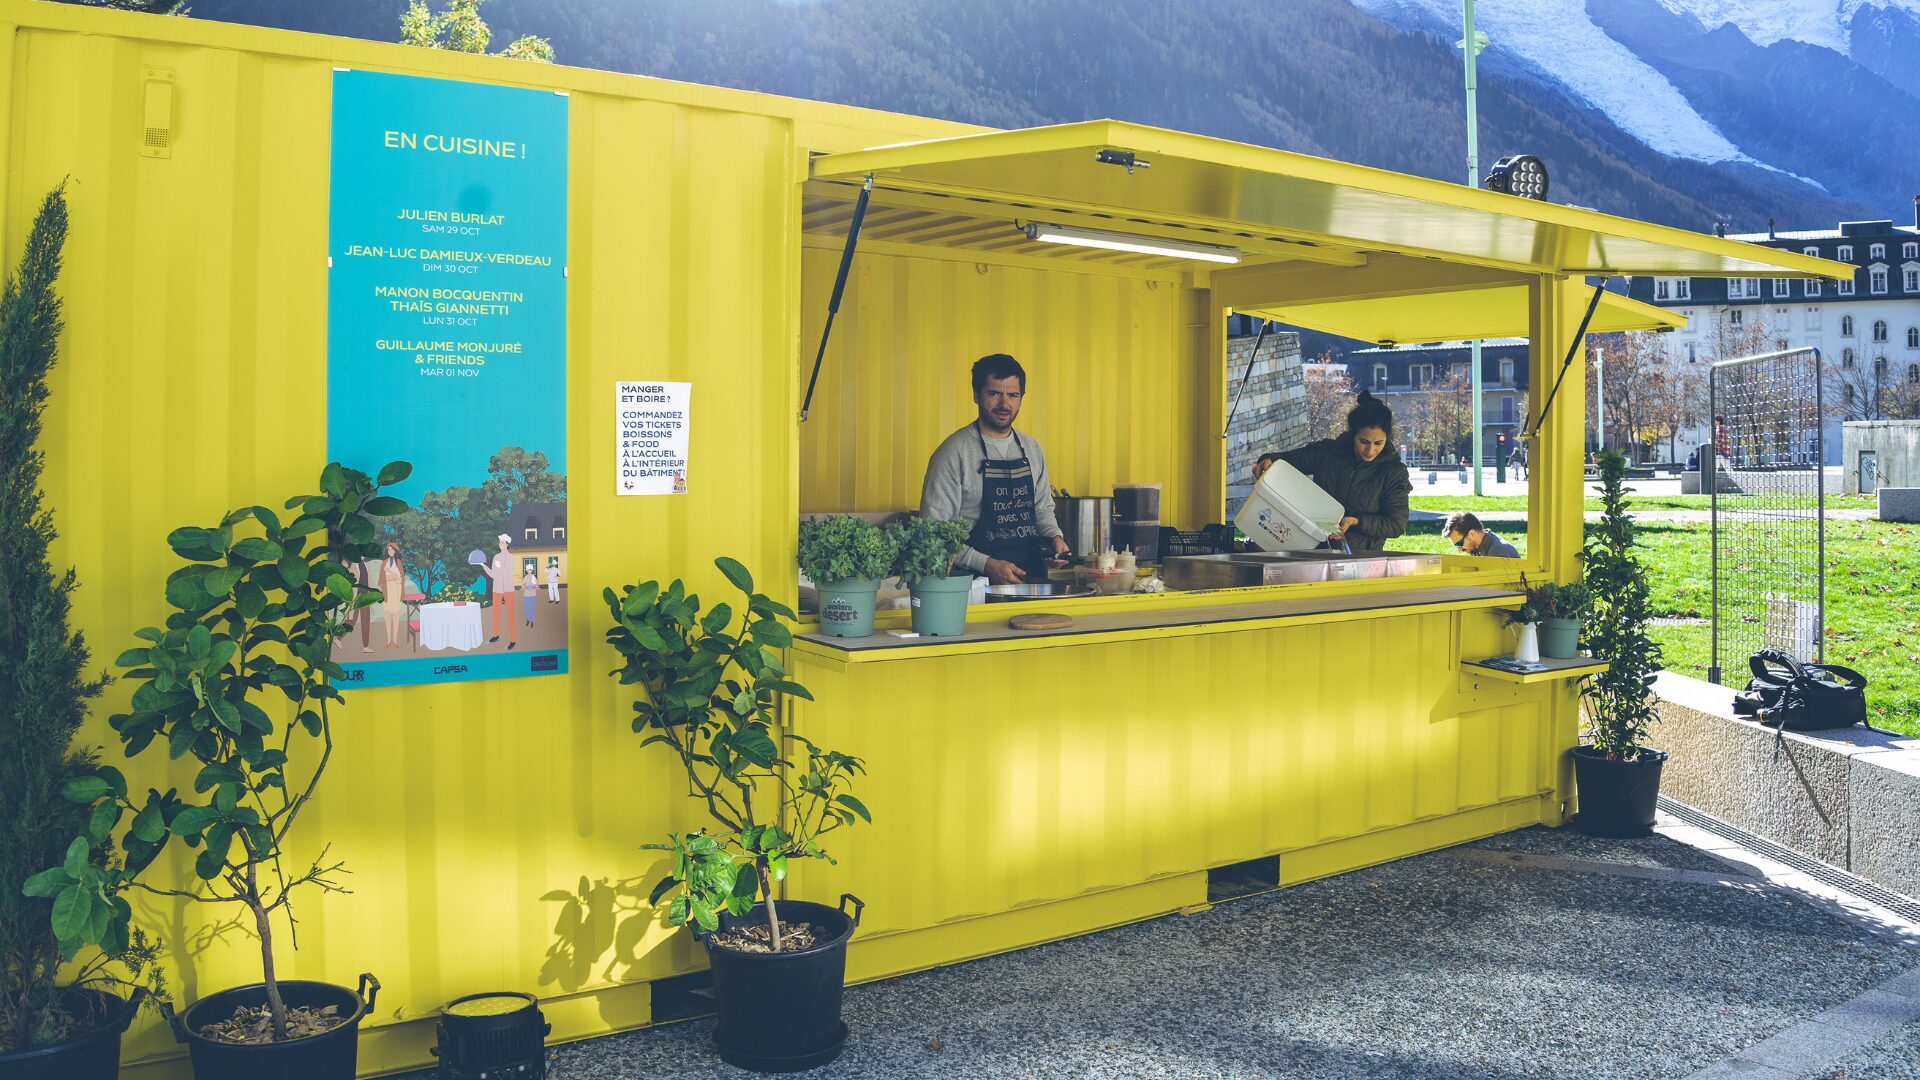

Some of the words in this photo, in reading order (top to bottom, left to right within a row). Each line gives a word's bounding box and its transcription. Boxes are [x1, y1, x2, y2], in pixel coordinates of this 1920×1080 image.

[385, 131, 417, 149] EN
[423, 134, 516, 158] CUISINE
[397, 209, 448, 222] JULIEN
[450, 212, 505, 225] BURLAT
[422, 224, 445, 233] SAM
[447, 226, 459, 234] 29
[459, 226, 481, 236] OCT
[344, 245, 417, 259] JEAN-LUC
[420, 249, 551, 267] DAMIEUX-VERDEAU
[423, 263, 442, 272] DIM
[444, 264, 457, 273] 30
[458, 265, 479, 274] OCT
[375, 286, 429, 298] MANON
[432, 288, 523, 303] BOCQUENTIN
[390, 300, 433, 313] THAÏS
[435, 302, 509, 316] GIANNETTI
[423, 316, 444, 325] LUN
[446, 317, 455, 325] 31
[457, 317, 478, 326] OCT
[375, 339, 454, 352] GUILLAUME
[457, 342, 522, 353] MONJURÉ
[415, 354, 424, 364] &
[427, 354, 485, 366] FRIENDS
[420, 368, 444, 376] MAR
[445, 368, 455, 377] 01
[457, 368, 480, 377] NOV
[621, 385, 664, 393] MANGER
[622, 395, 635, 403] ET
[636, 395, 666, 403] BOIRE
[622, 411, 683, 419] COMMANDEZ
[622, 421, 644, 429] VOS
[645, 421, 682, 429] TICKETS
[623, 430, 672, 438] BOISSONS
[622, 440, 630, 448] &
[632, 440, 660, 448] FOOD
[622, 449, 630, 458] À
[632, 450, 677, 458] L'ACCUEIL
[622, 458, 630, 467] À
[632, 458, 685, 468] L'INTÉRIEUR
[623, 469, 637, 477] DU
[640, 468, 683, 478] BÂTIMENT
[996, 487, 1008, 496] on
[997, 513, 1018, 524] avec
[823, 607, 858, 621] desert
[434, 665, 468, 675] CAPSA
